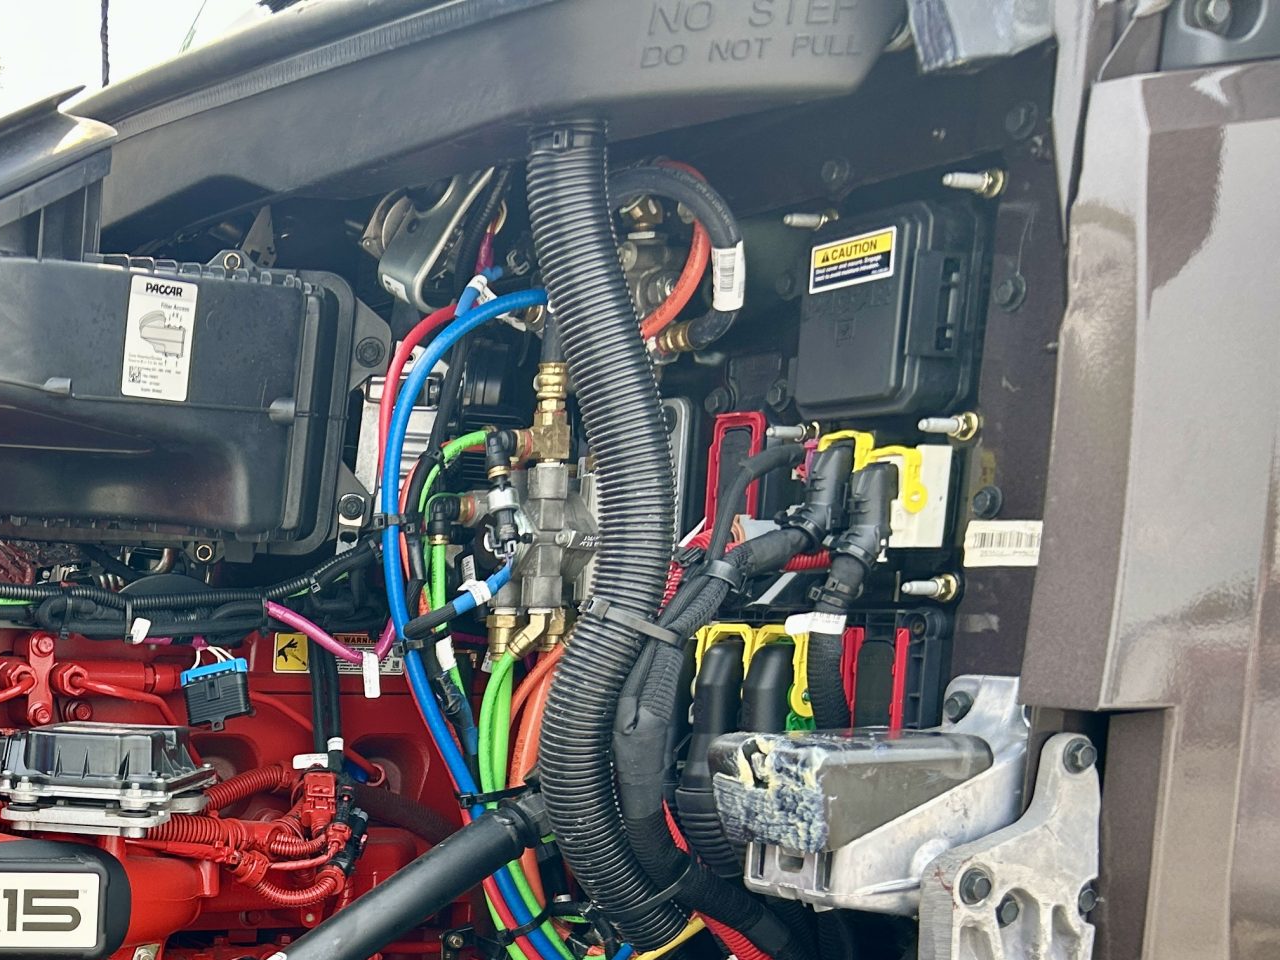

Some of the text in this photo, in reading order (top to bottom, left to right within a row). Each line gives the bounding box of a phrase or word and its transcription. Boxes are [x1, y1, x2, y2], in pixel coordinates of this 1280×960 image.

[648, 0, 857, 36] NO STEP
[641, 34, 863, 69] DO NOT PULL
[832, 240, 877, 260] CAUTION
[146, 282, 183, 297] PACCAR
